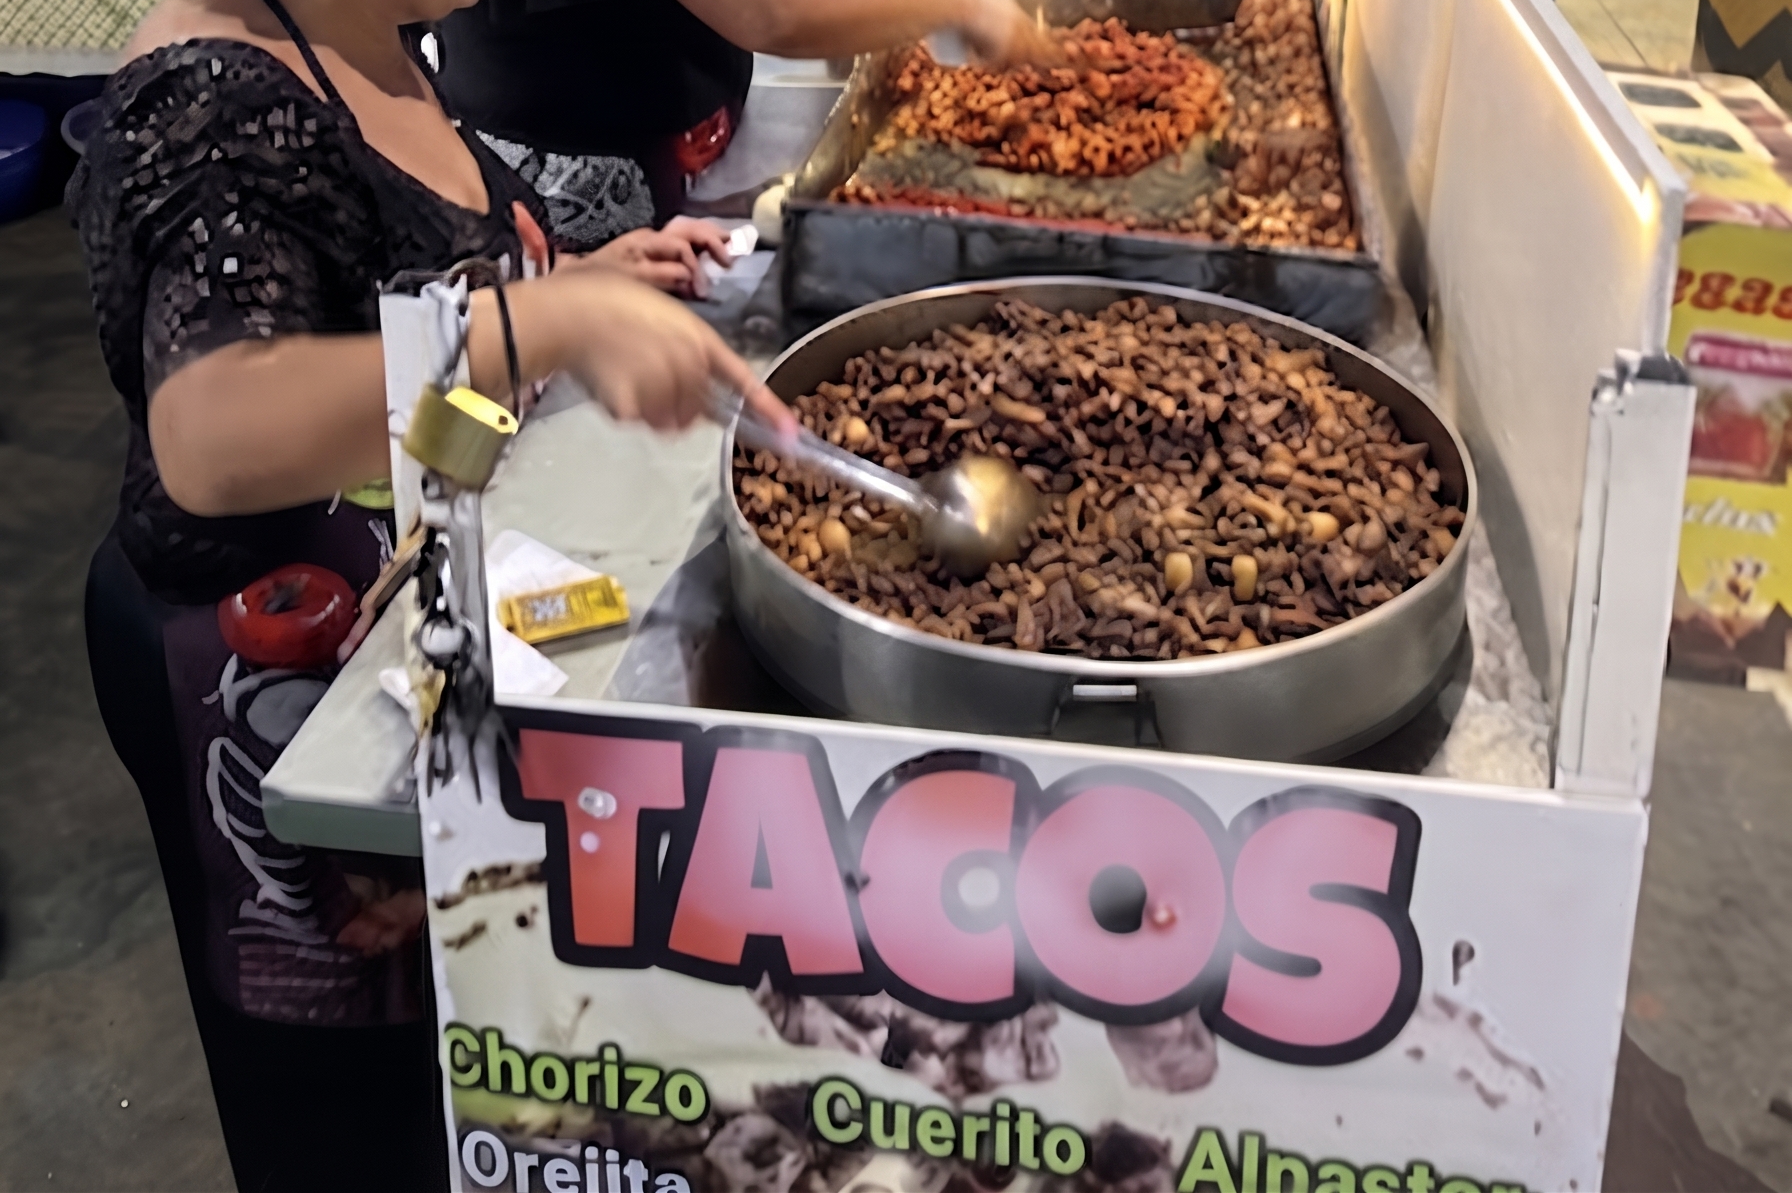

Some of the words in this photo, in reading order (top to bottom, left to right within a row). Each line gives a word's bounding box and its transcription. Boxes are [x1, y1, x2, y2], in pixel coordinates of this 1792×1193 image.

[510, 721, 1411, 1055] TACOS
[444, 1023, 709, 1123] Chorizo
[811, 1078, 1087, 1176] Cuerito
[1176, 1127, 1525, 1193] Alpast
